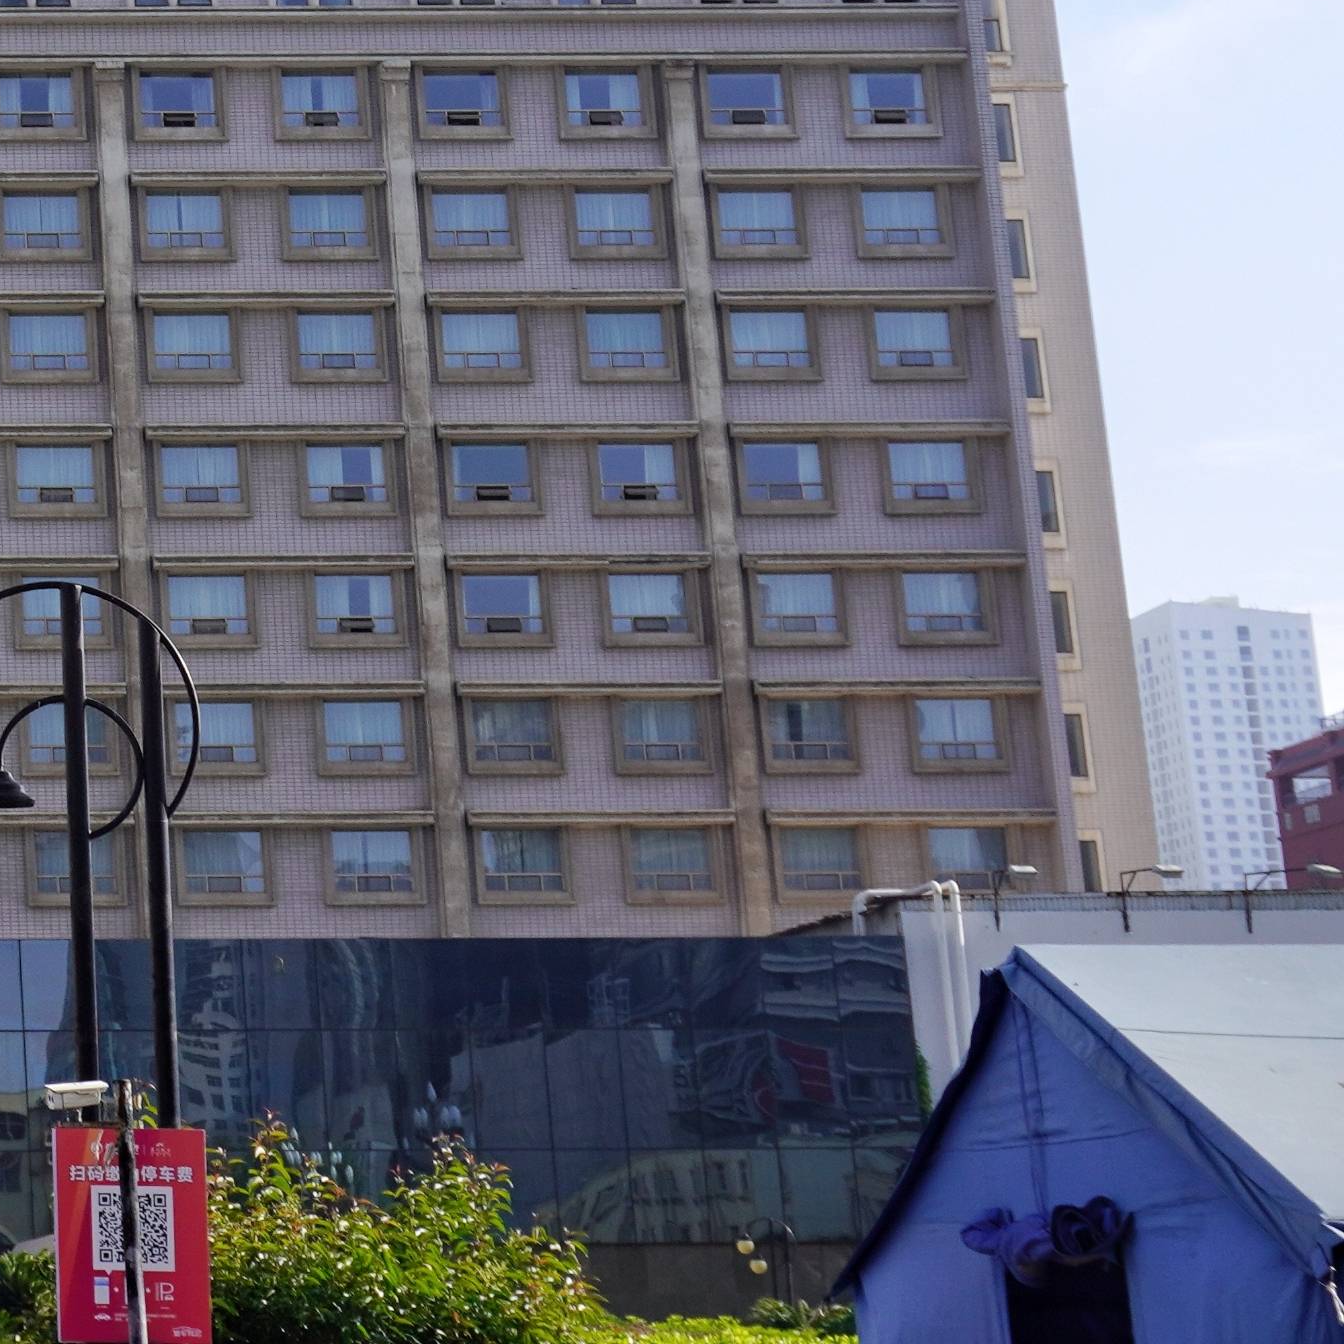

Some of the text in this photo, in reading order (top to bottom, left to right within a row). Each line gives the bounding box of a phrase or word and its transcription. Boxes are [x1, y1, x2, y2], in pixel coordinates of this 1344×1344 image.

[69, 1165, 193, 1183] 扫码缴停车费
